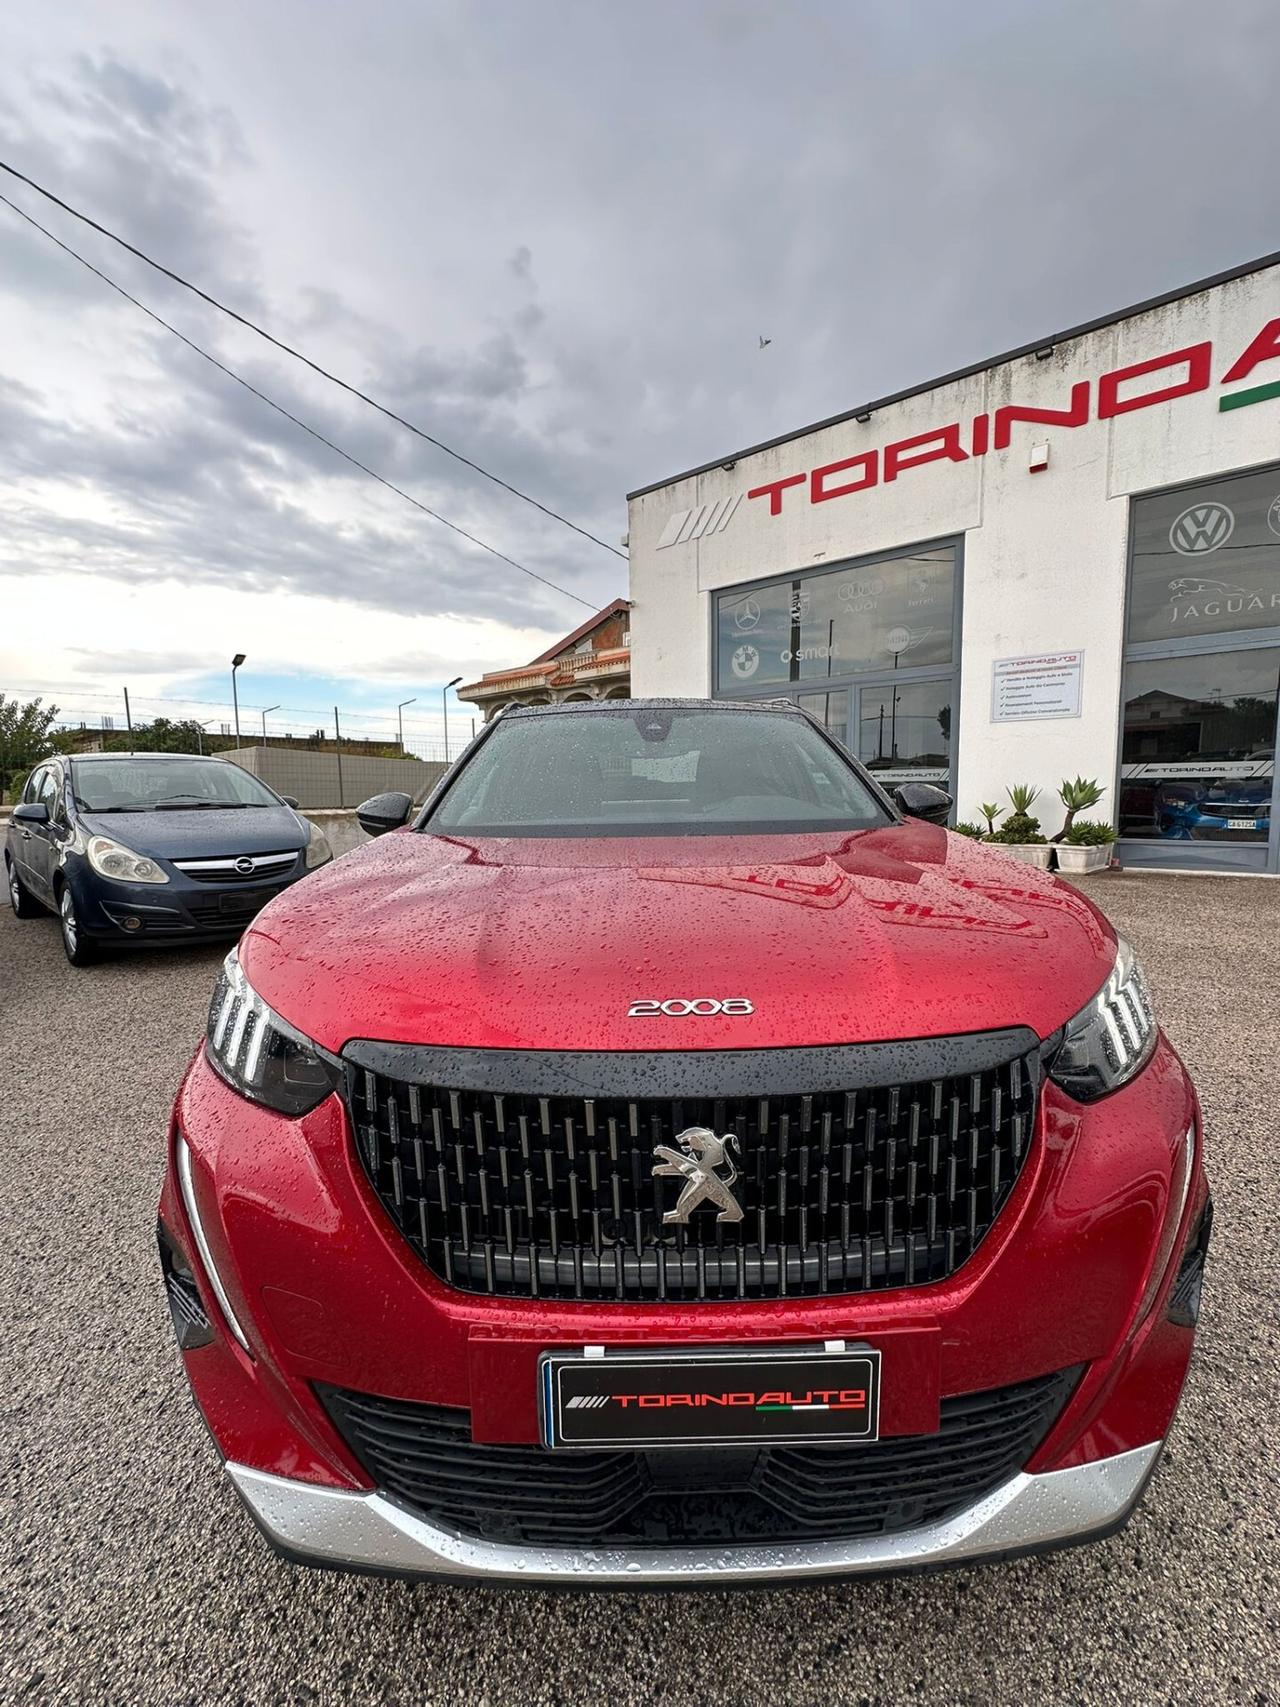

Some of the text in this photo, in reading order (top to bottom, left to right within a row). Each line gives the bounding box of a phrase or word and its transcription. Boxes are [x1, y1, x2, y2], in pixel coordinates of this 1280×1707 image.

[796, 642, 840, 661] smart
[627, 998, 756, 1017] 2008
[611, 1389, 866, 1408] TORINOAUTO
